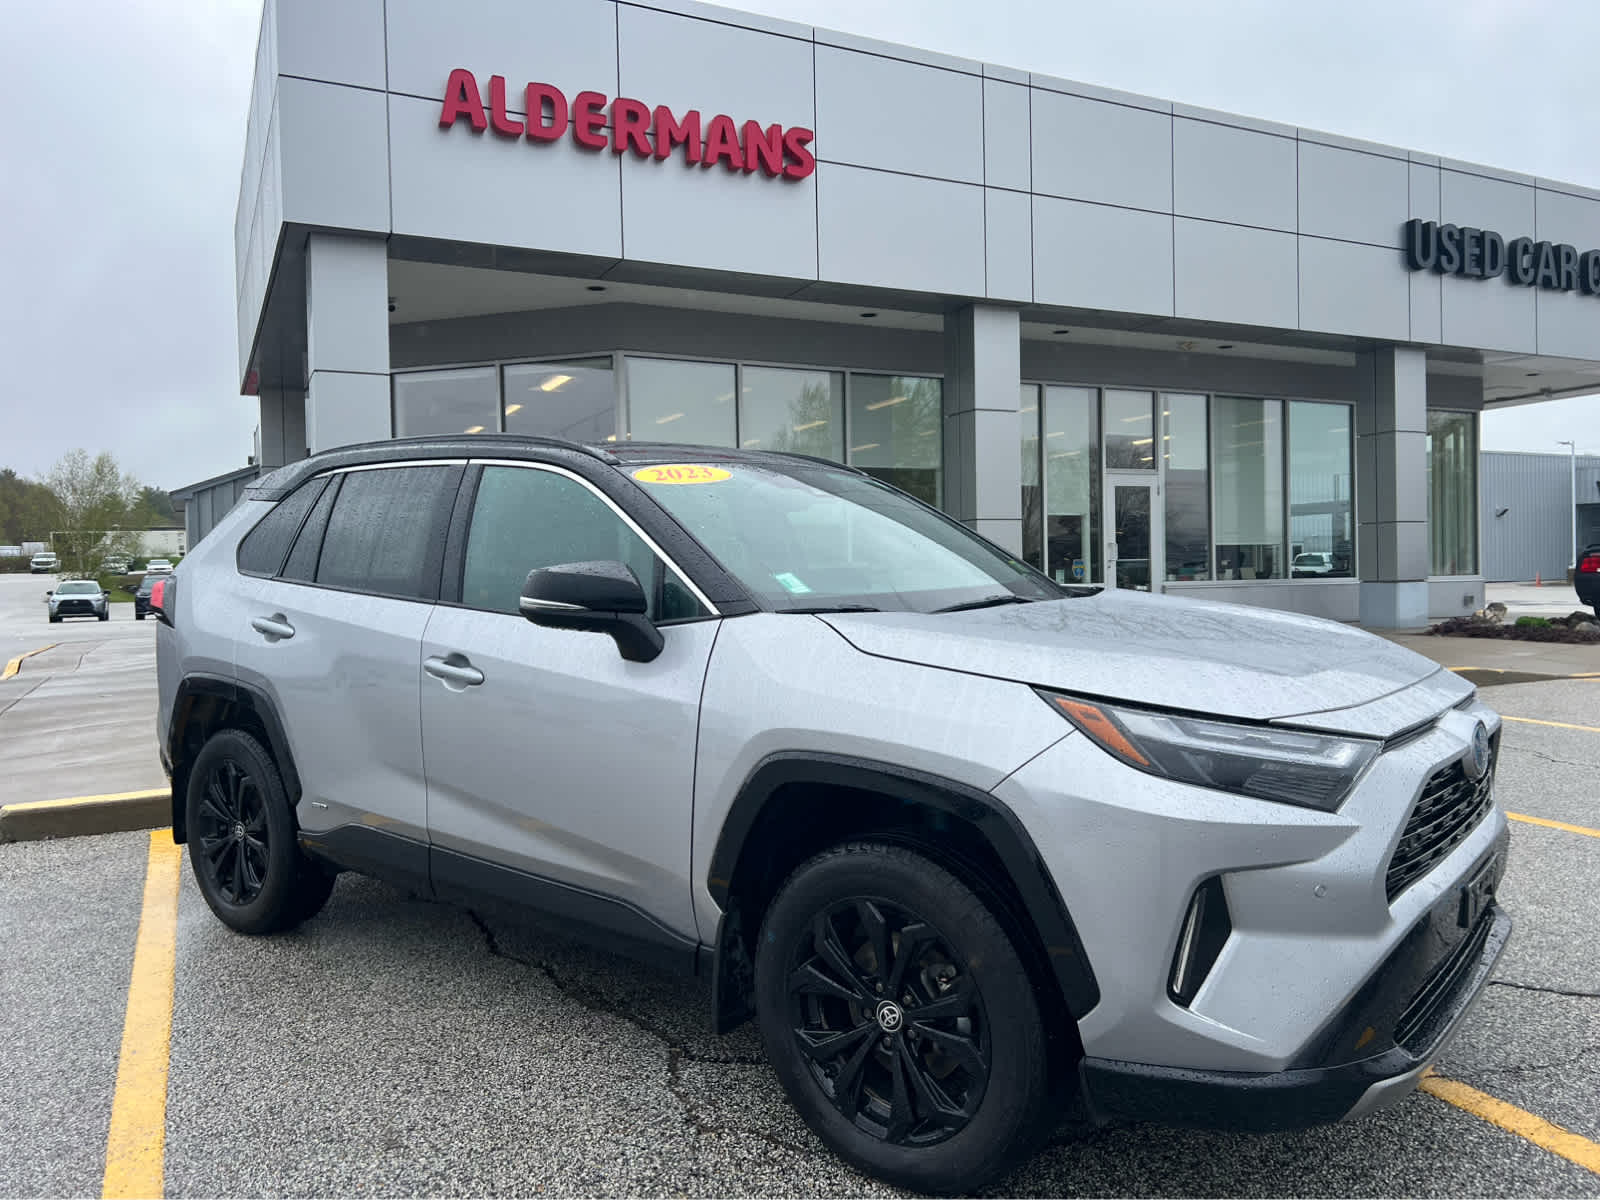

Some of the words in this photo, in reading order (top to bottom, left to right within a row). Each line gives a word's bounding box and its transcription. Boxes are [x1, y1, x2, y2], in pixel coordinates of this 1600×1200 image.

[439, 68, 816, 181] ALDERMANS
[1407, 218, 1505, 279] USED
[1509, 236, 1578, 290] CAR
[650, 467, 713, 481] 2023
